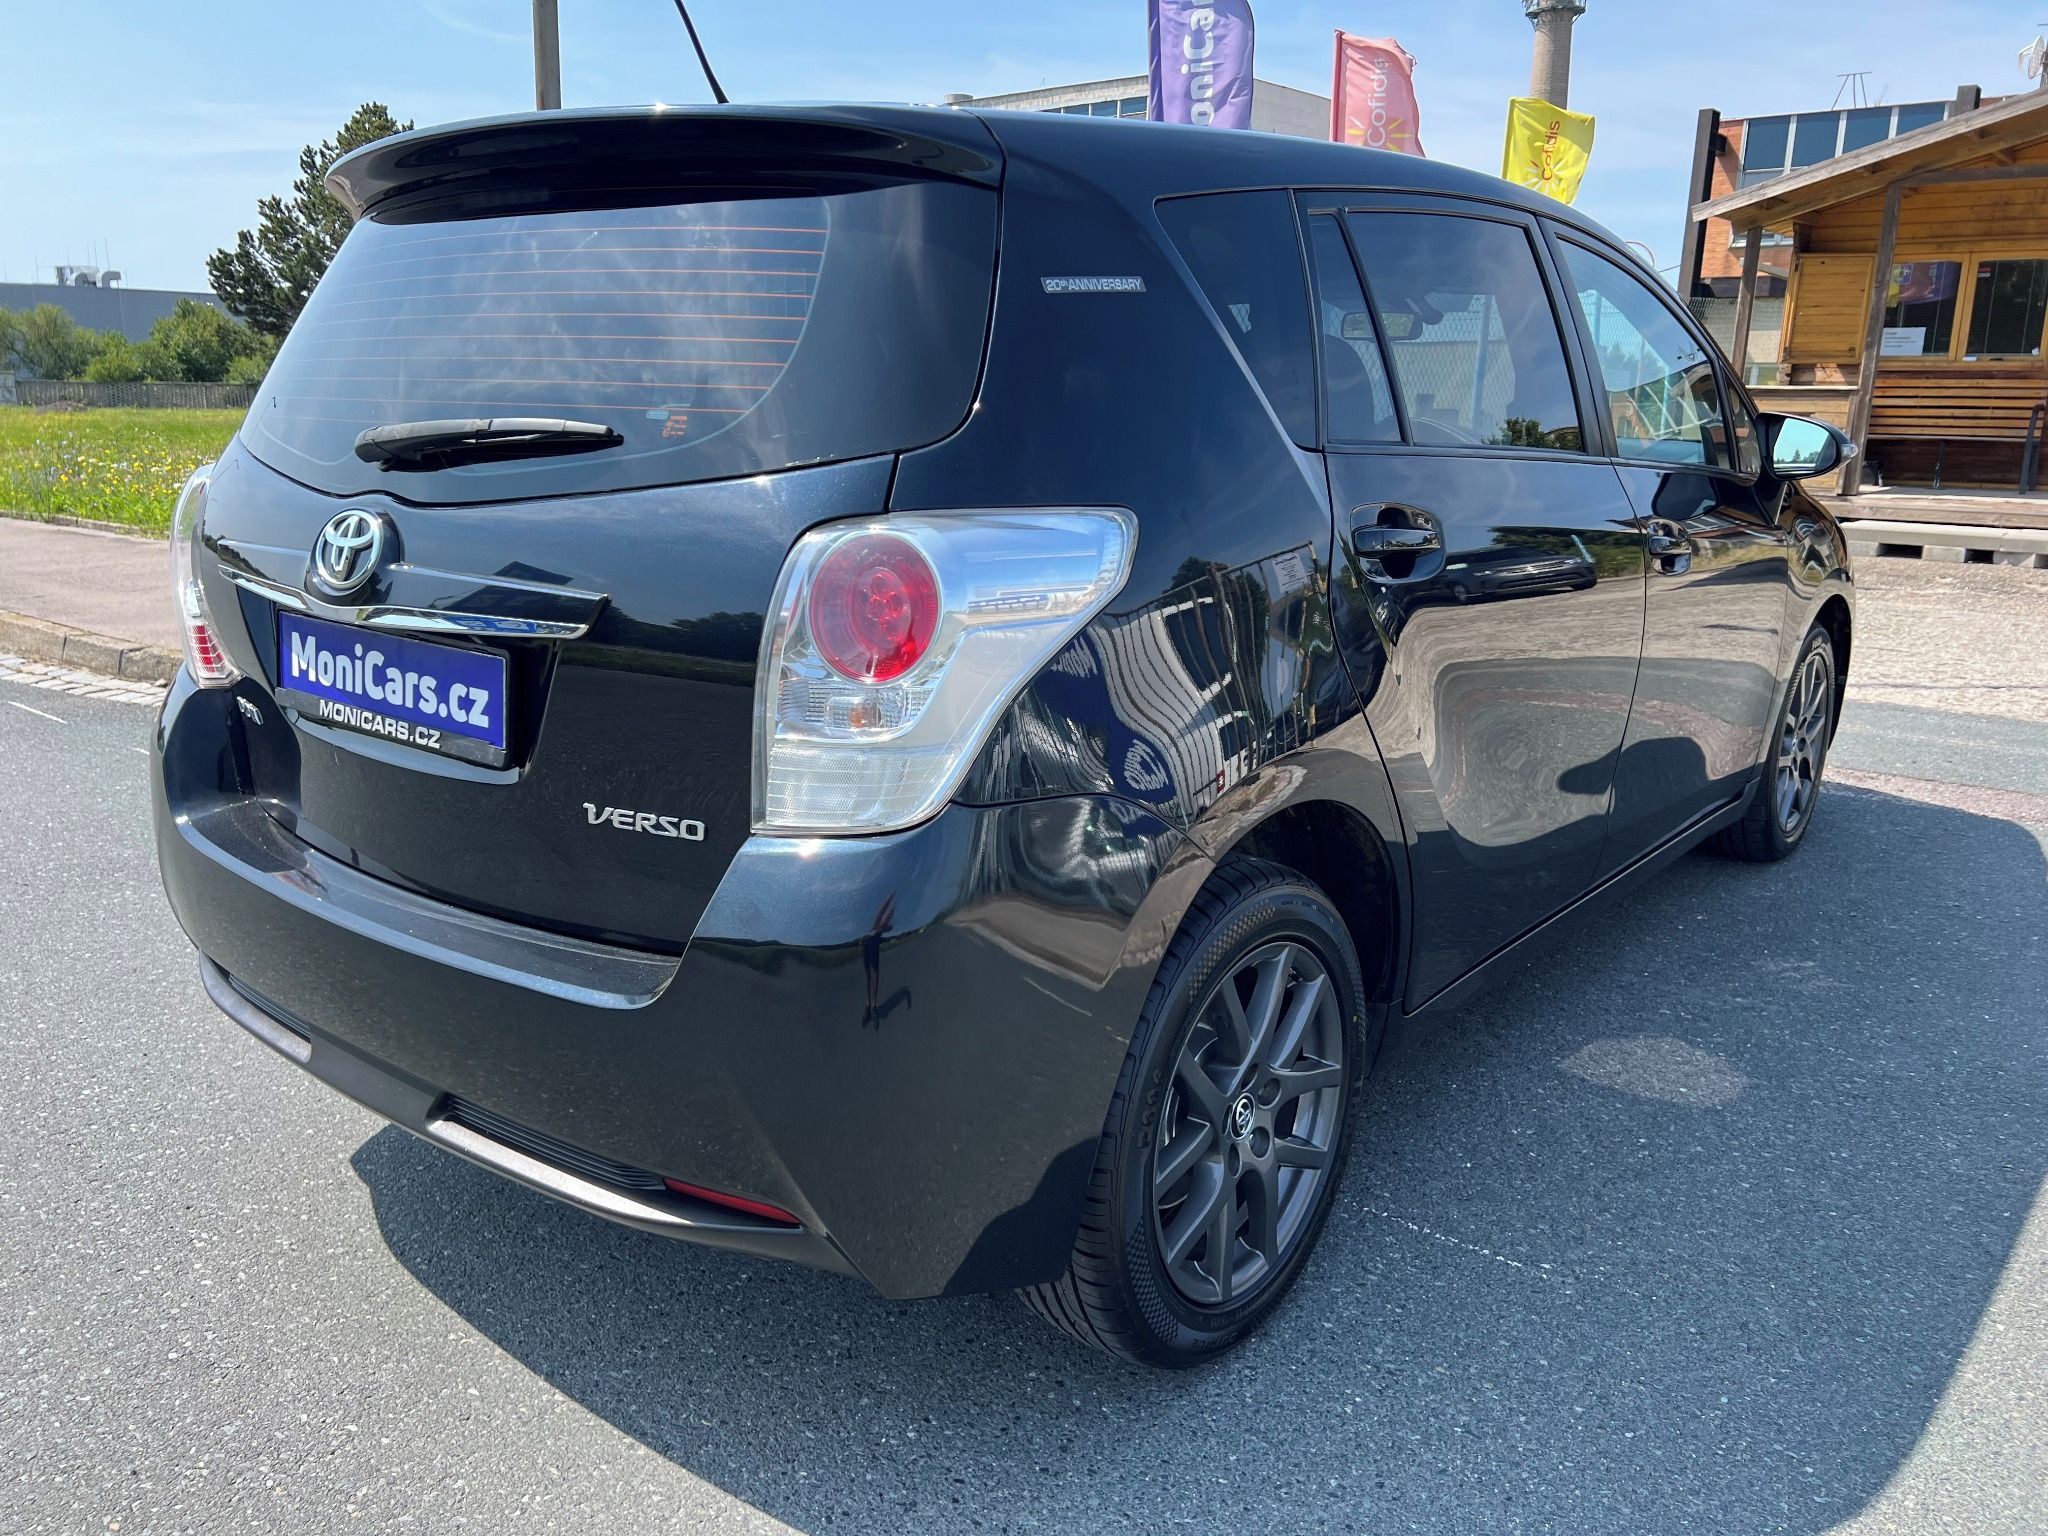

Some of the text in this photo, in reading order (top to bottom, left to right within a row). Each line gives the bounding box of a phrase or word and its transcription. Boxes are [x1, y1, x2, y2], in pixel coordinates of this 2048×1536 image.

[1367, 58, 1388, 147] Cofidis
[1542, 120, 1561, 181] Cofidis
[1045, 278, 1141, 291] 20th ANNIVERSARY
[291, 631, 490, 728] MoniCars.cz
[319, 699, 441, 749] MONICARS.CZ
[582, 802, 705, 841] VERSO
